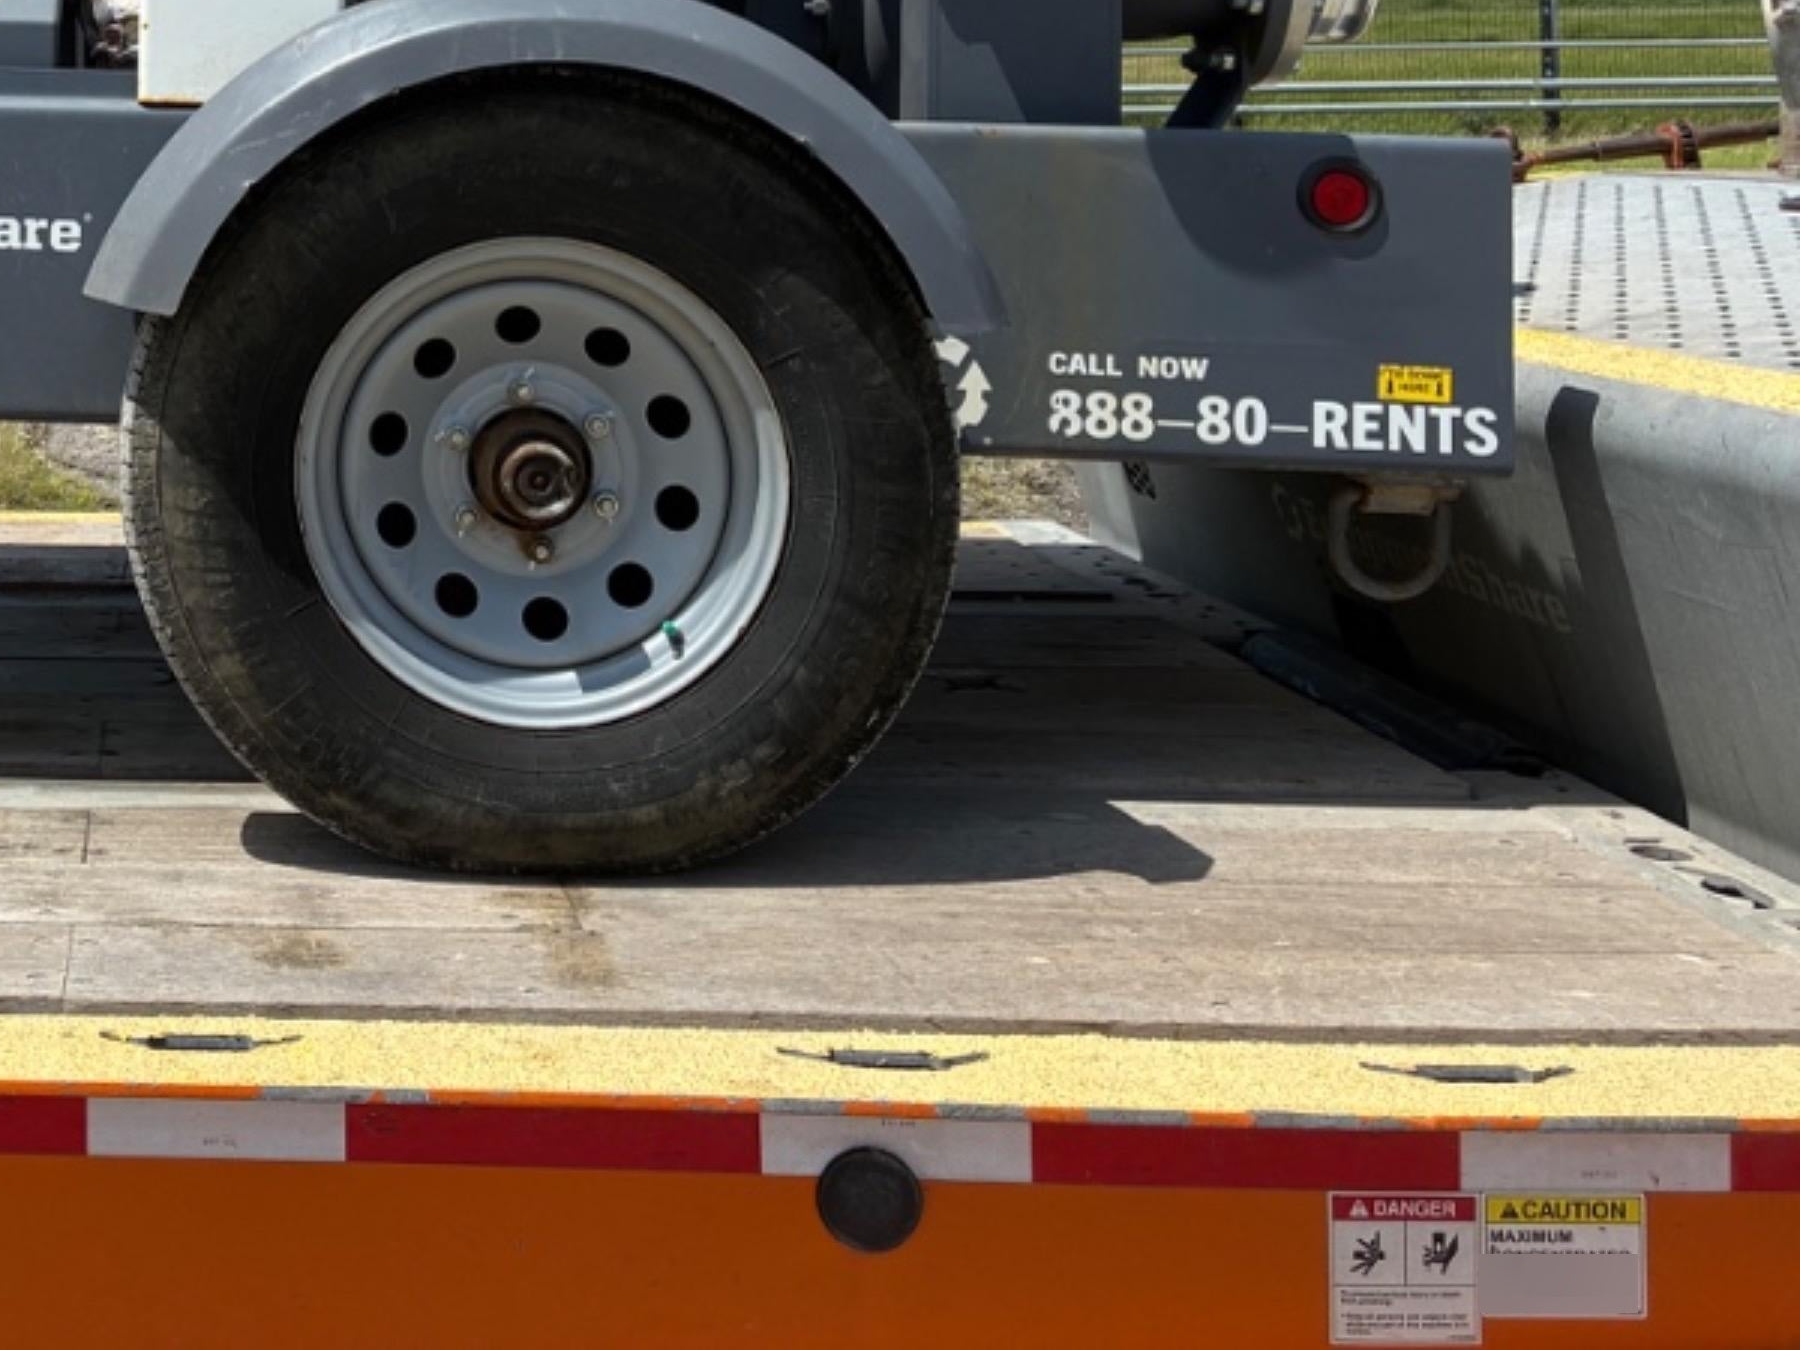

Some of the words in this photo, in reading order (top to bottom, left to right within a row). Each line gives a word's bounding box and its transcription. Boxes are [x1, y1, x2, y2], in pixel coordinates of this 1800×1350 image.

[1048, 351, 1123, 377] CALL
[1138, 356, 1210, 380] NOW
[1373, 1200, 1456, 1217] DANGER
[1521, 1201, 1628, 1220] CAUTION
[1490, 1229, 1574, 1244] MAXIMUM
